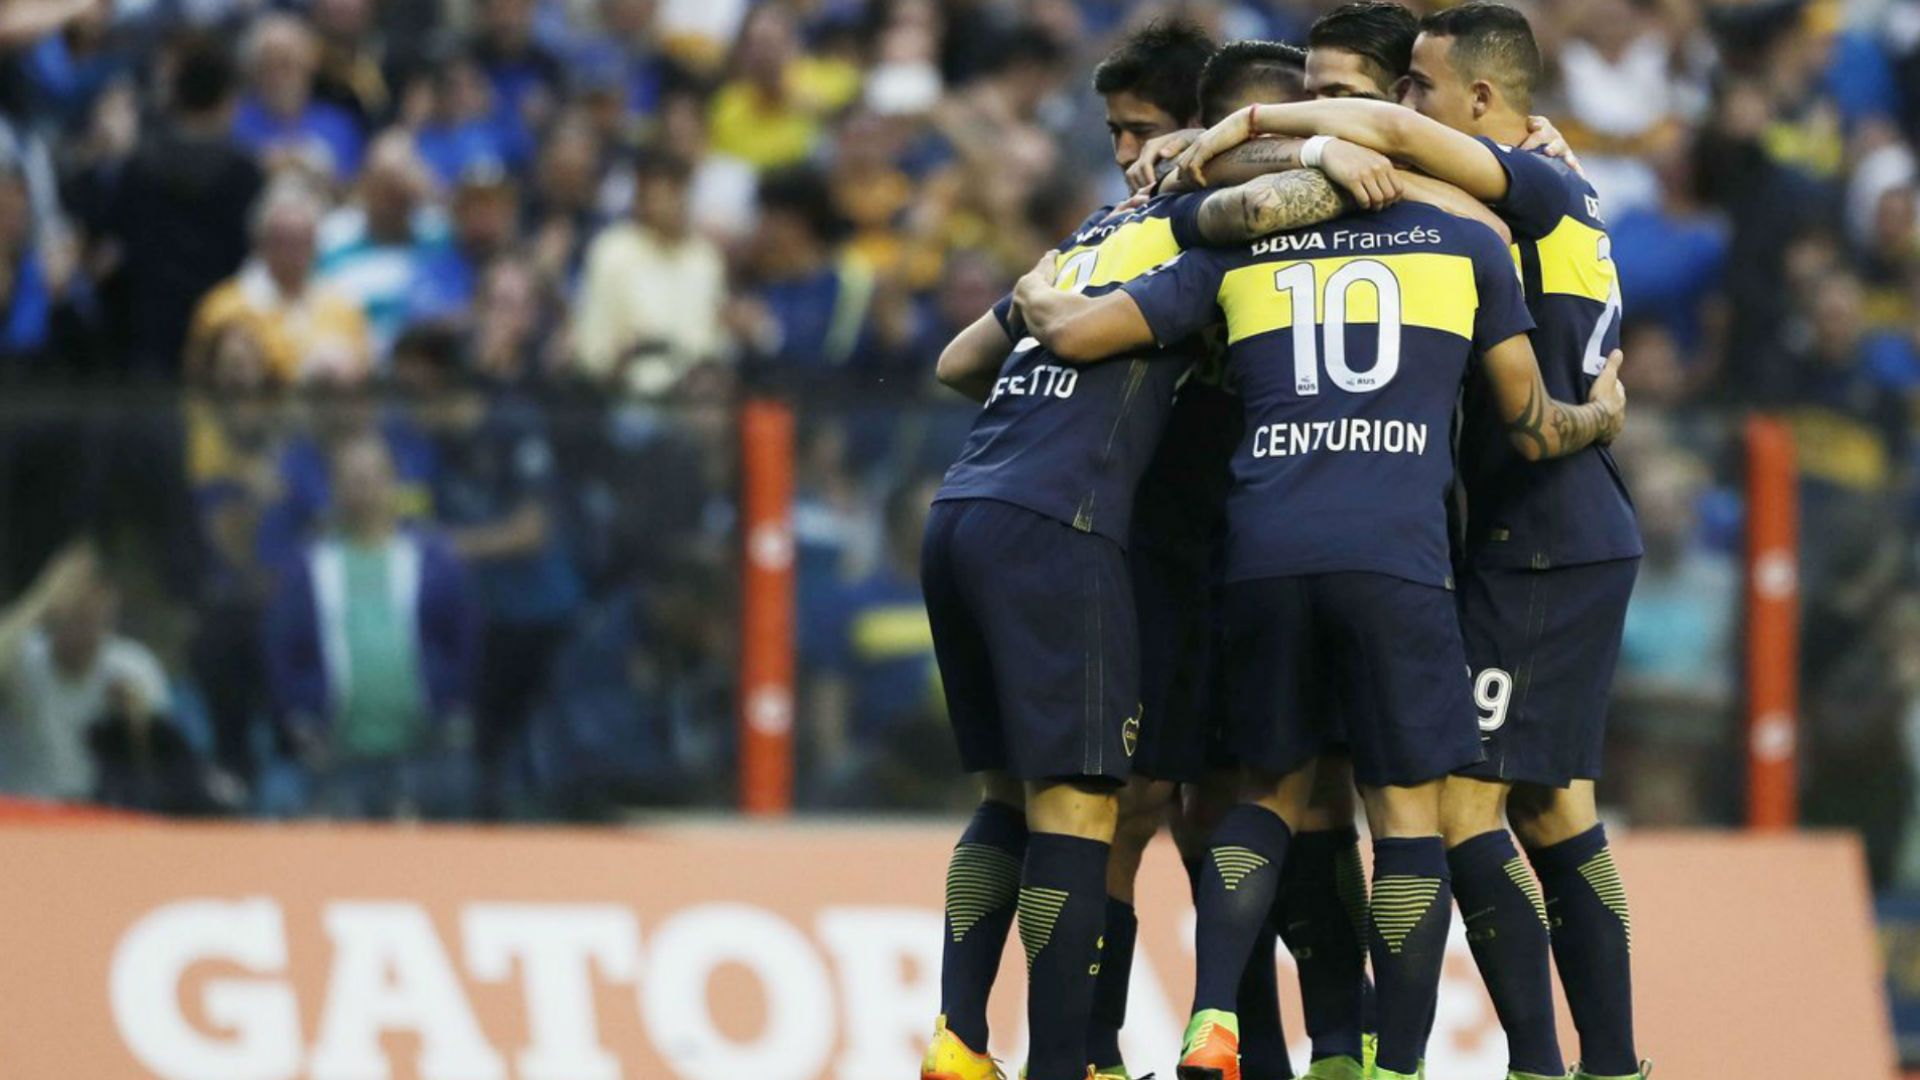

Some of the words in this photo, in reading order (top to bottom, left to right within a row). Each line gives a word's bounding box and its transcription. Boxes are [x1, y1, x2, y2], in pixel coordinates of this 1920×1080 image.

[1252, 231, 1326, 256] BBVA
[1333, 225, 1441, 250] Francés
[1274, 258, 1401, 396] 10
[1252, 418, 1427, 458] CENTURION
[1465, 664, 1513, 731] 9
